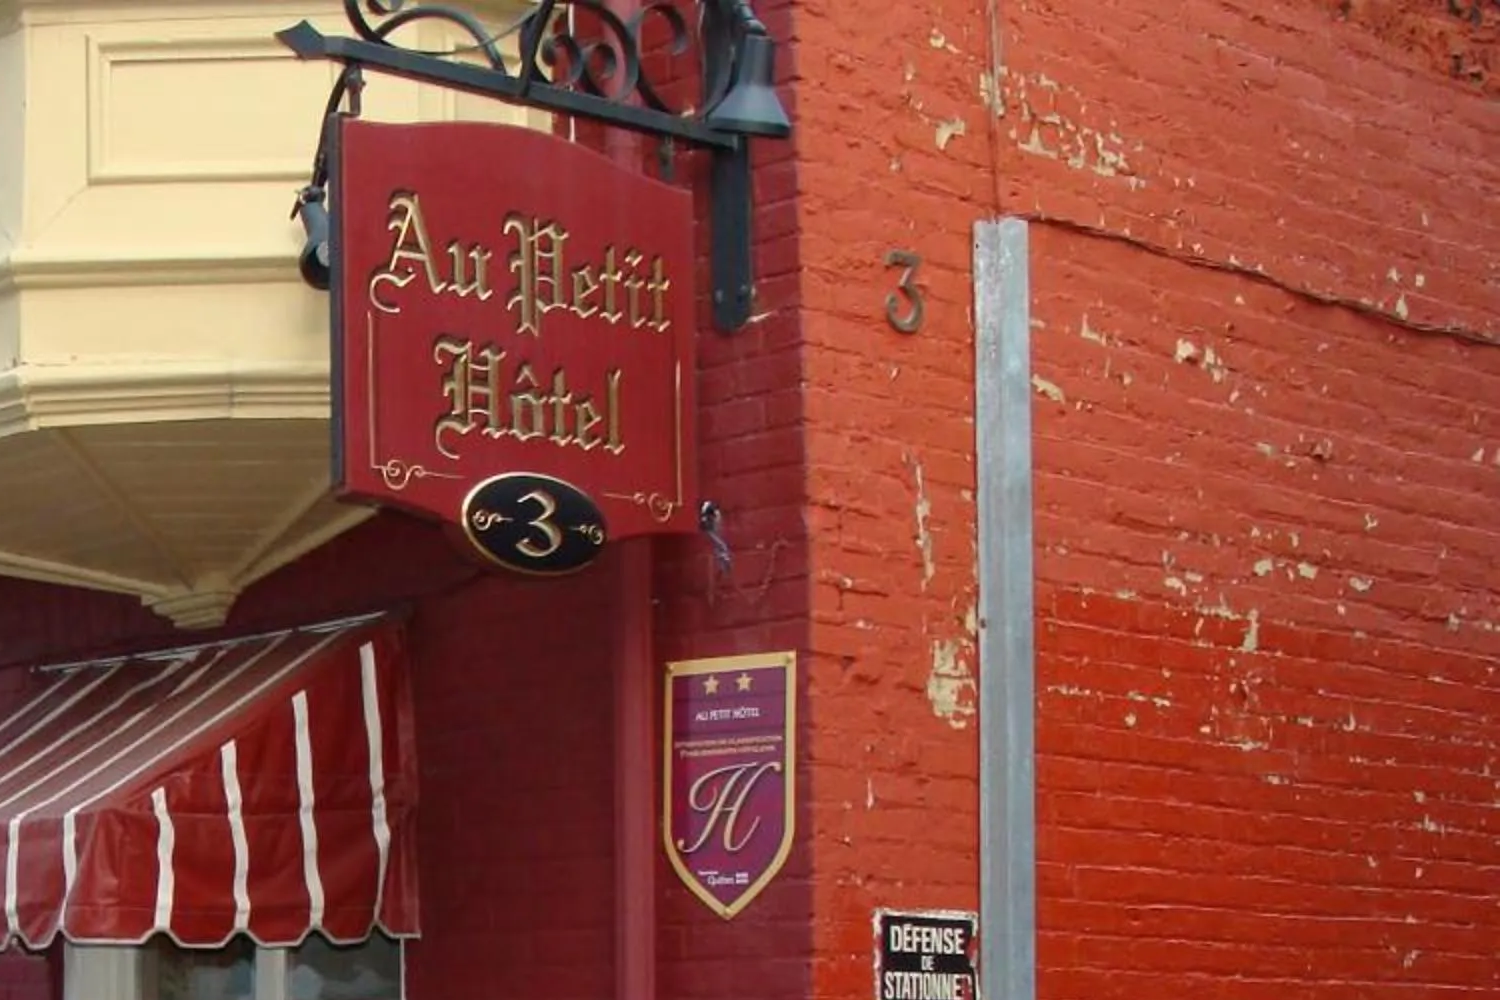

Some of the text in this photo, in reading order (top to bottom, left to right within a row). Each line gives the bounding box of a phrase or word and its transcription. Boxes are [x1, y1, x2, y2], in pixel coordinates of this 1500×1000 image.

[370, 190, 672, 337] Au Petit
[884, 249, 924, 334] 3
[434, 334, 626, 460] Hôtel
[515, 491, 563, 557] 3
[889, 923, 965, 955] DÉFENSE
[921, 955, 934, 971] DE
